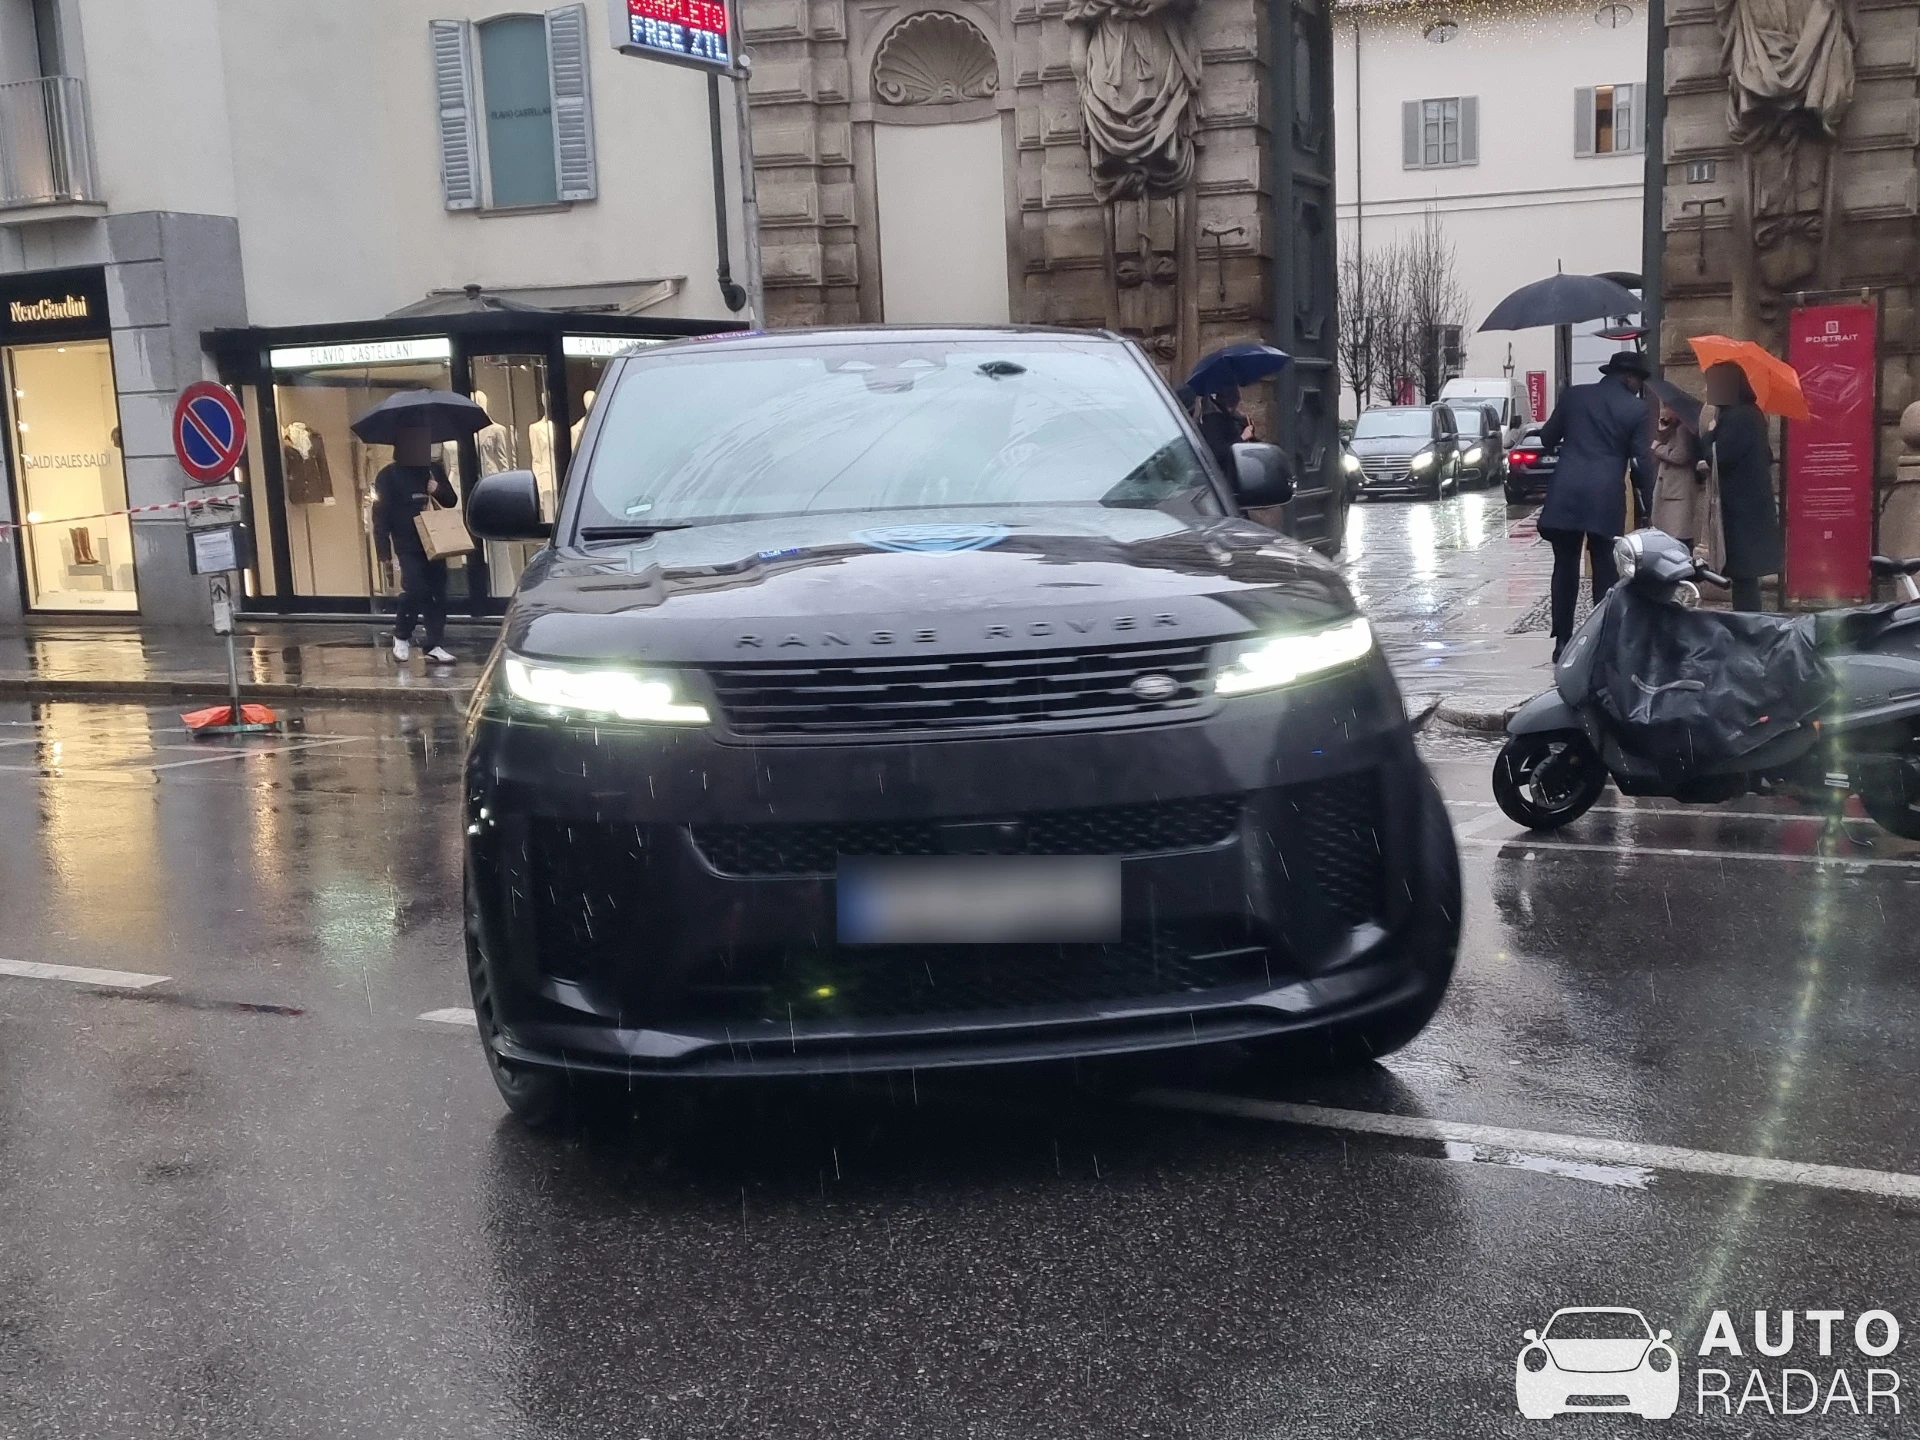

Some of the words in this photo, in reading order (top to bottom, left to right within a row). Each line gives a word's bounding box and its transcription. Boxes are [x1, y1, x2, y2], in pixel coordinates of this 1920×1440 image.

[631, 14, 684, 52] FREE
[690, 27, 727, 61] ZTL
[514, 106, 551, 118] CASTELLAN
[1693, 164, 1709, 181] 11
[10, 294, 88, 322] NeroGiardini
[579, 338, 612, 354] FLAVIO
[1805, 333, 1859, 343] PORTRAIT
[310, 349, 345, 364] FLAVIO
[351, 343, 413, 361] CASTELLANI
[26, 454, 54, 470] SALDI
[55, 454, 83, 469] SALES
[84, 453, 111, 468] SALDI
[734, 629, 938, 648] RANGE
[983, 612, 1180, 640] ROVER
